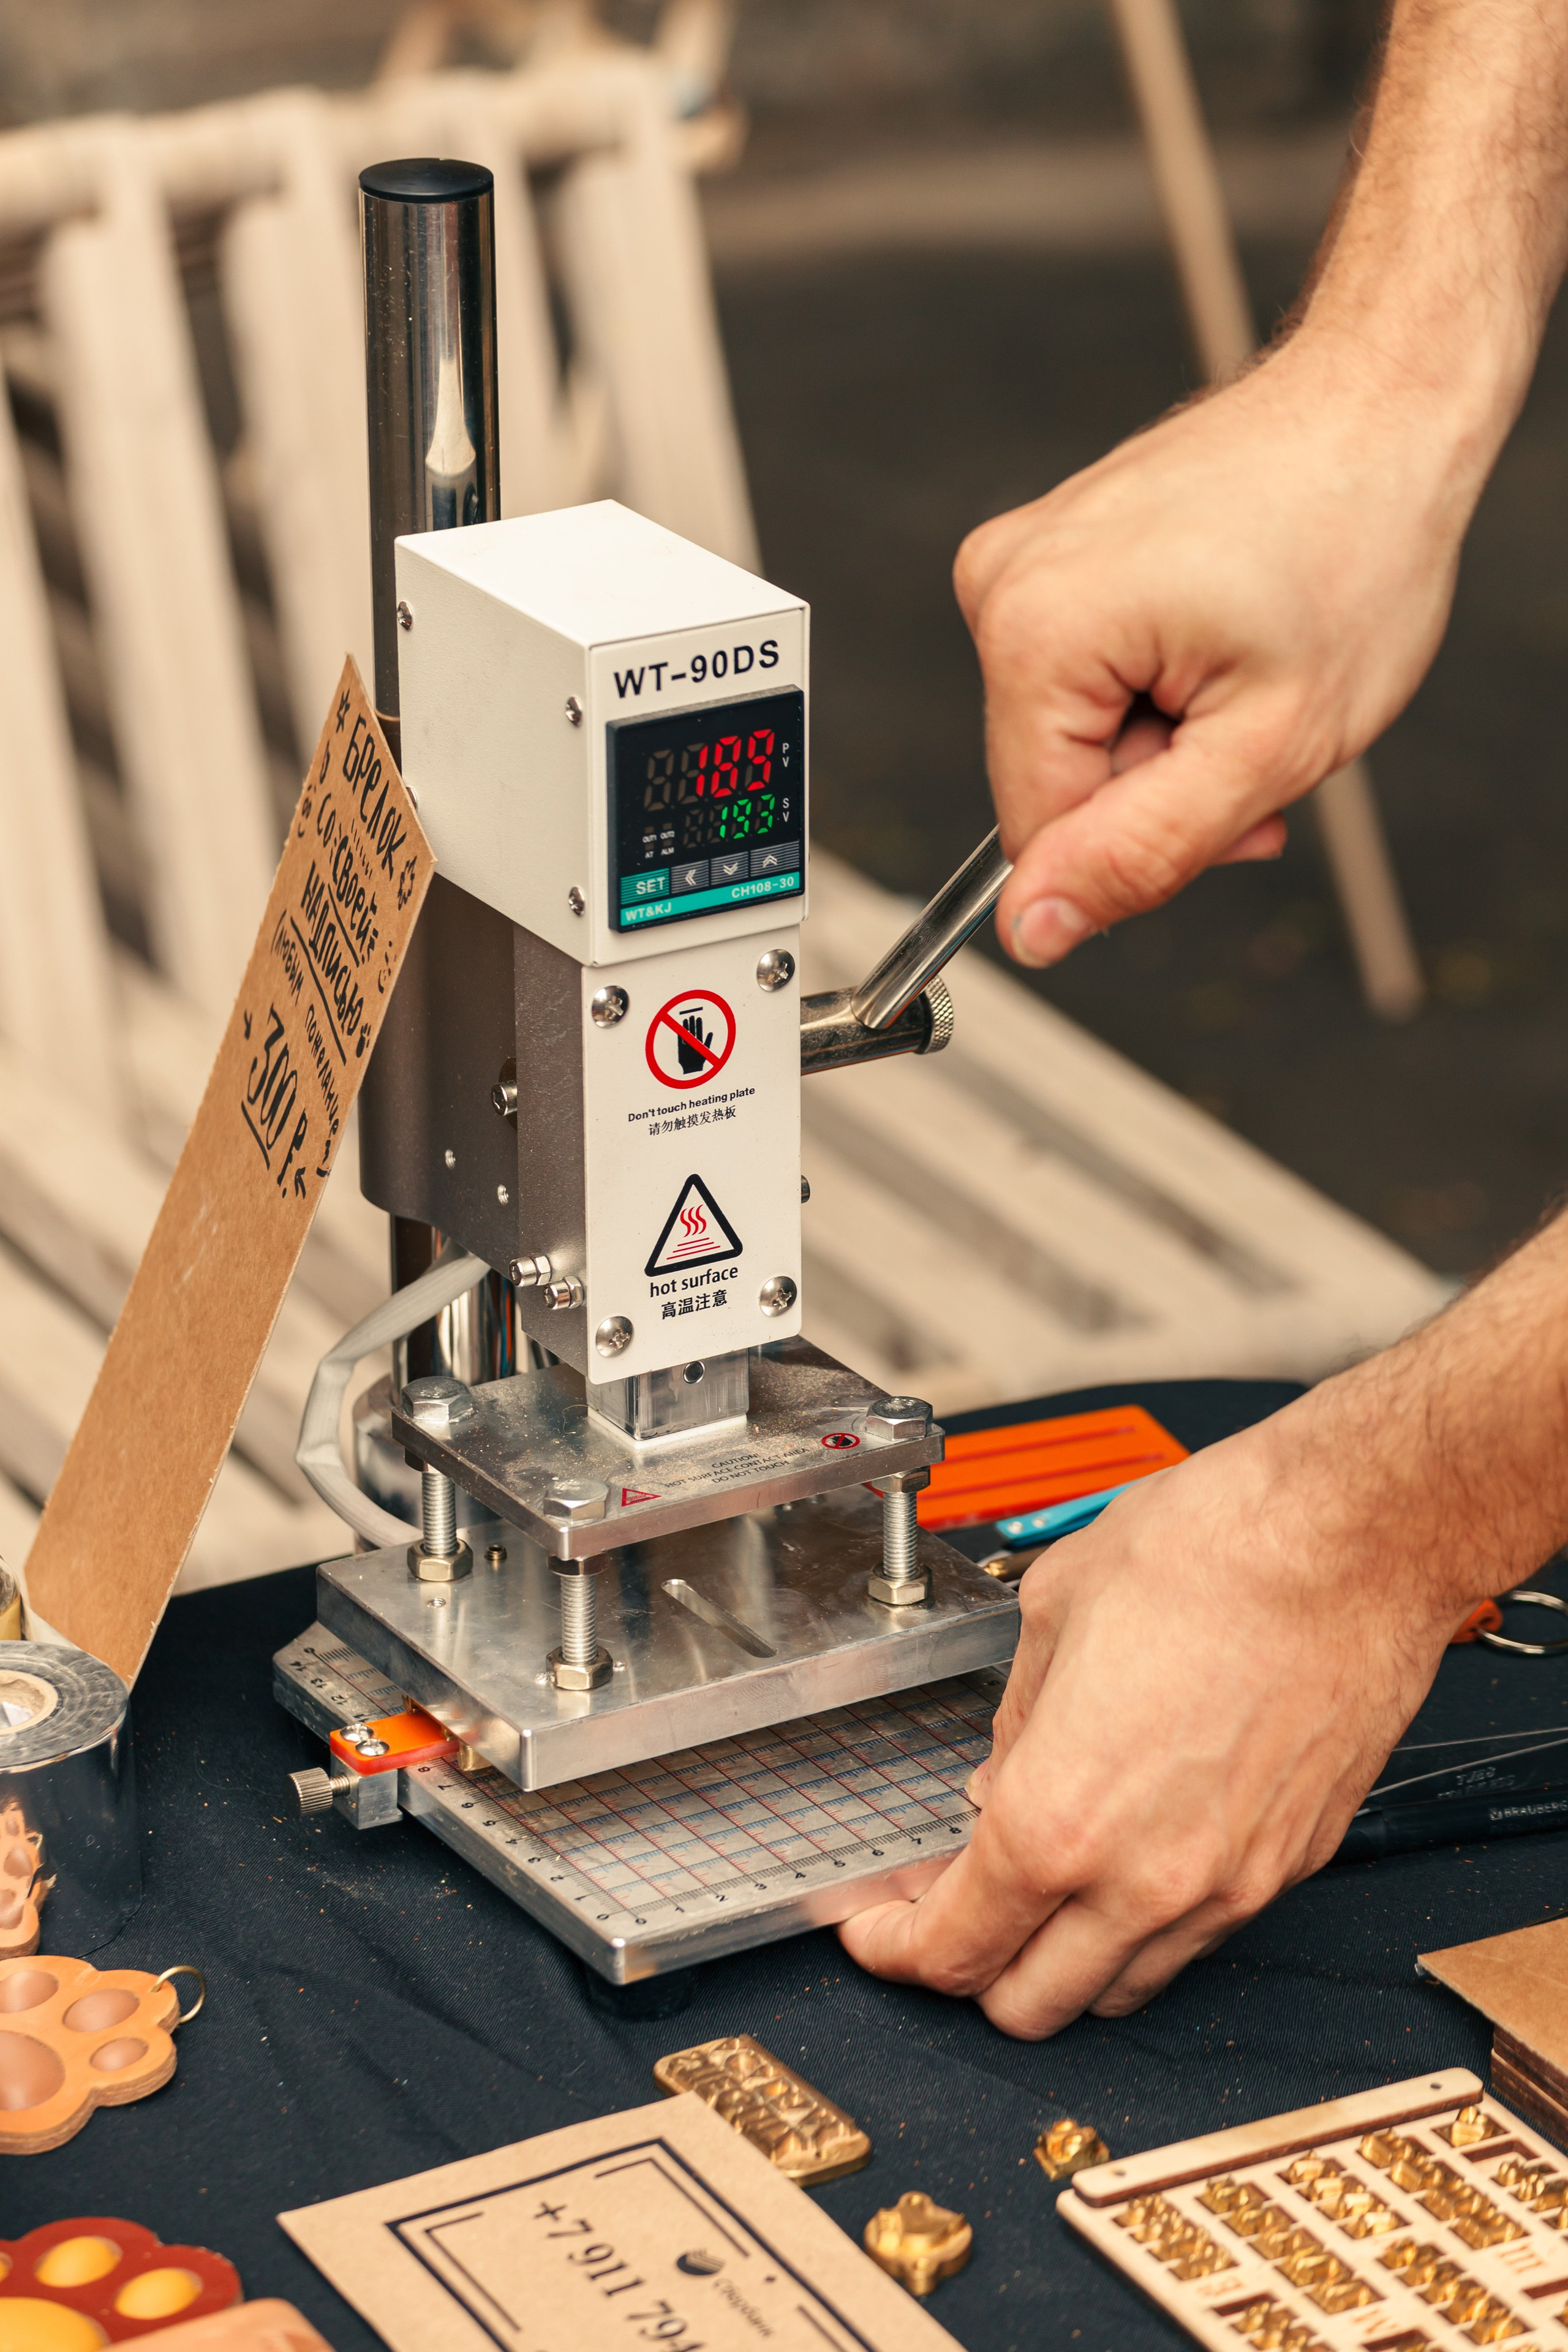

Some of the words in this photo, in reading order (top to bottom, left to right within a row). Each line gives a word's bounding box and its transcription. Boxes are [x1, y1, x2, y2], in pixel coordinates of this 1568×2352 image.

[614, 639, 780, 699] WT-90DS
[696, 728, 775, 798] 189
[719, 793, 775, 839] 193
[625, 901, 672, 921] WT&KJ
[731, 875, 795, 899] CH108-30
[635, 876, 666, 895] SET
[247, 1001, 298, 1151] 300
[628, 1108, 655, 1122] Don't
[657, 1101, 687, 1117] touch
[688, 1092, 728, 1109] heating
[729, 1087, 756, 1102] plate
[647, 1104, 737, 1137] 请勿触摸发热板
[649, 1278, 677, 1298] hot
[680, 1266, 739, 1291] surface
[660, 1289, 728, 1321] 高温注意
[664, 1479, 687, 1488] HOT
[687, 1466, 734, 1482] SURFACE
[734, 1455, 780, 1471] CONTACT
[783, 1447, 810, 1458] AREA
[711, 1452, 760, 1469] CAUTION!
[711, 1475, 729, 1484] DO
[731, 1470, 753, 1479] NOT
[754, 1460, 790, 1473] TOUCH
[567, 2242, 646, 2297] 911
